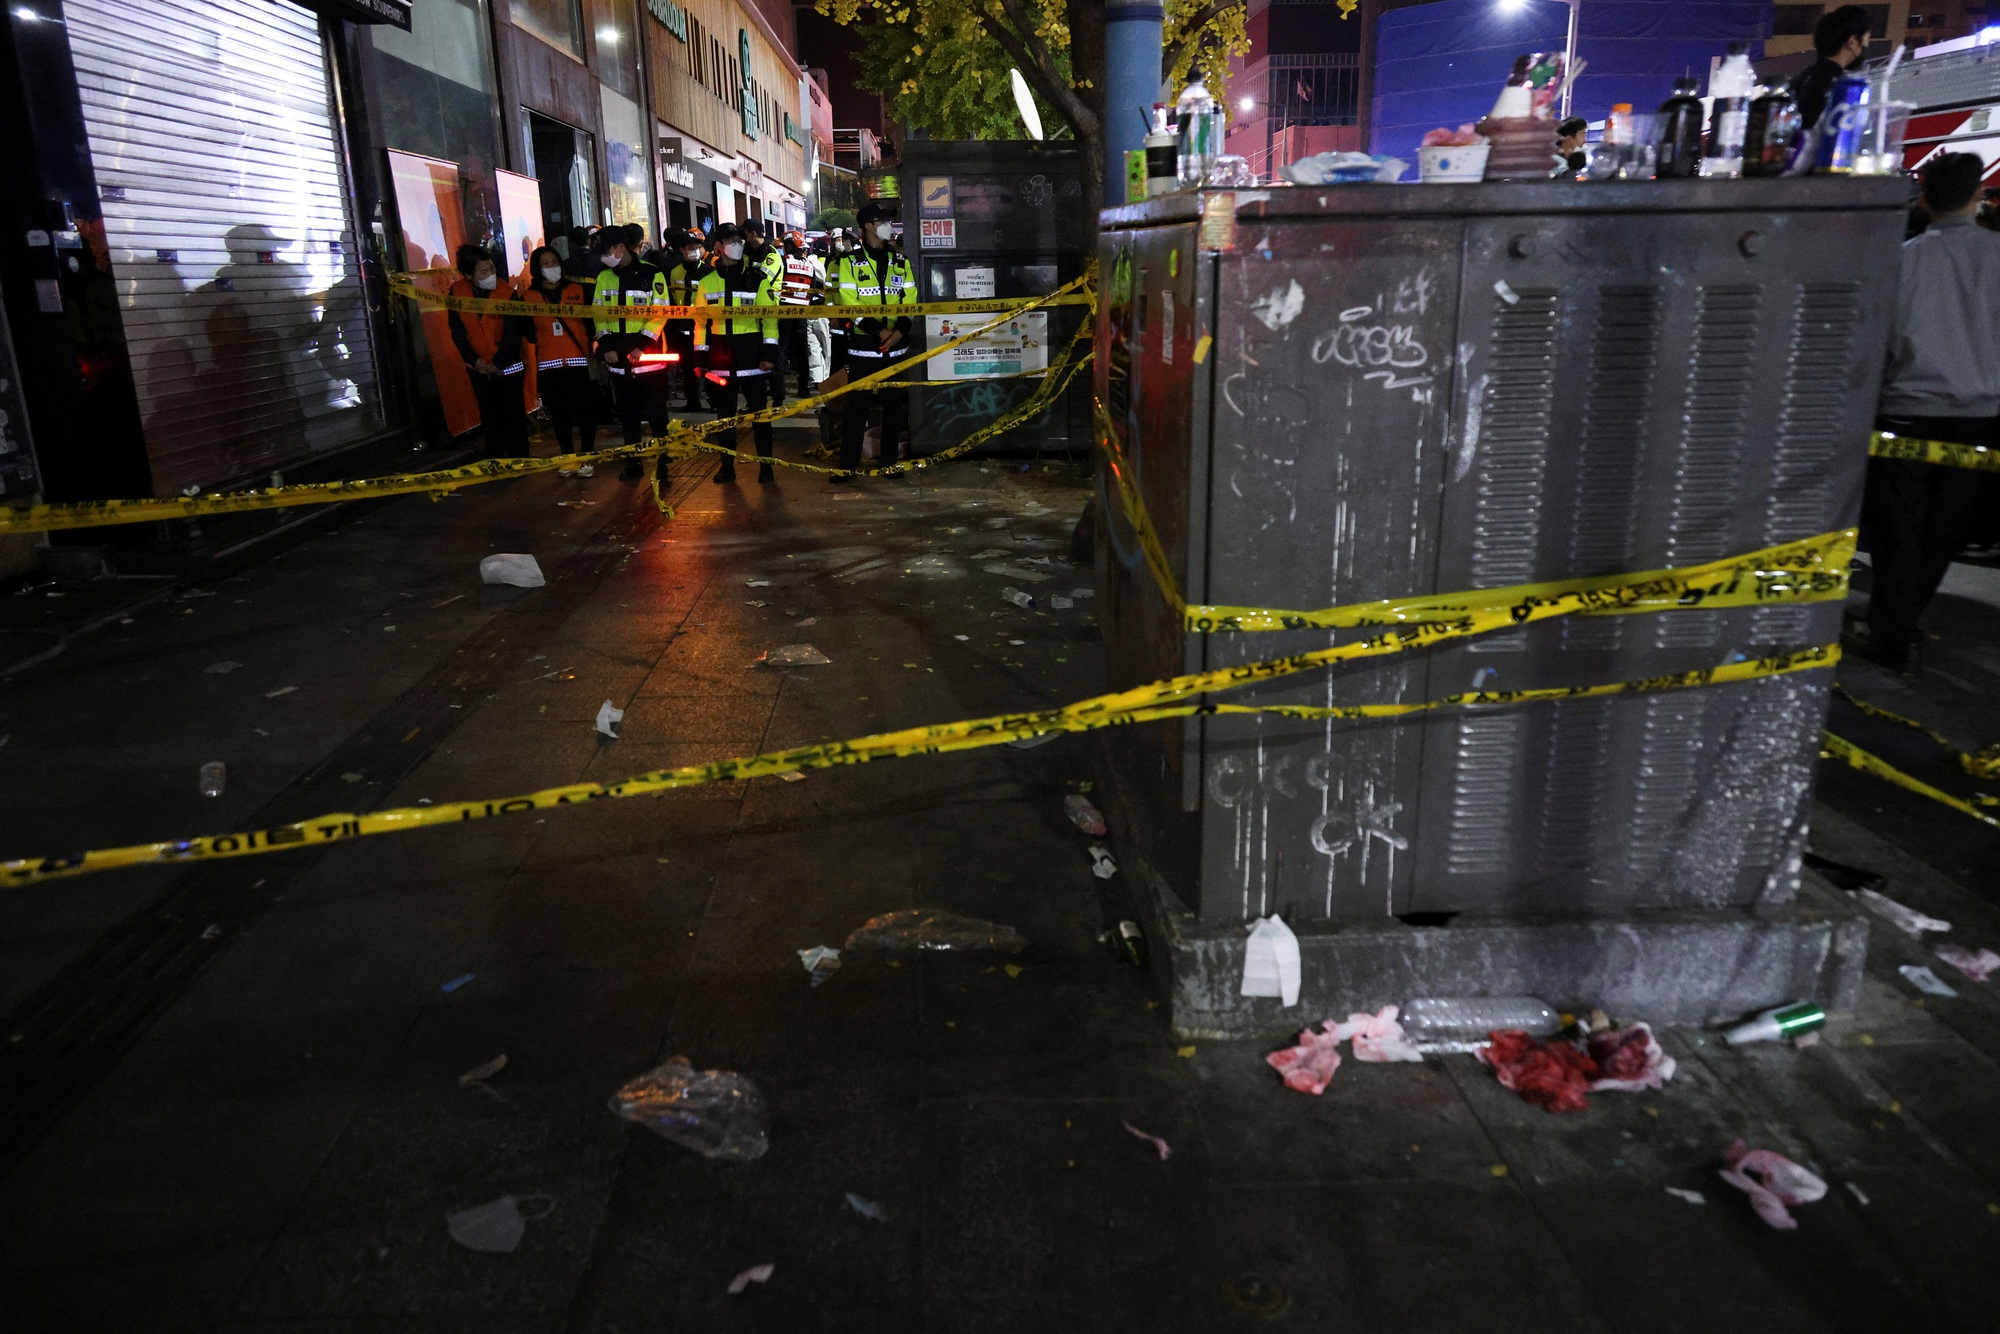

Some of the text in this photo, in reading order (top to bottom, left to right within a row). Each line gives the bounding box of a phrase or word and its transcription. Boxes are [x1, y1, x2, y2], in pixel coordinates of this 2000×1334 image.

[660, 146, 675, 154] cker
[922, 220, 953, 236] 금이빨
[953, 348, 975, 356] 그래도
